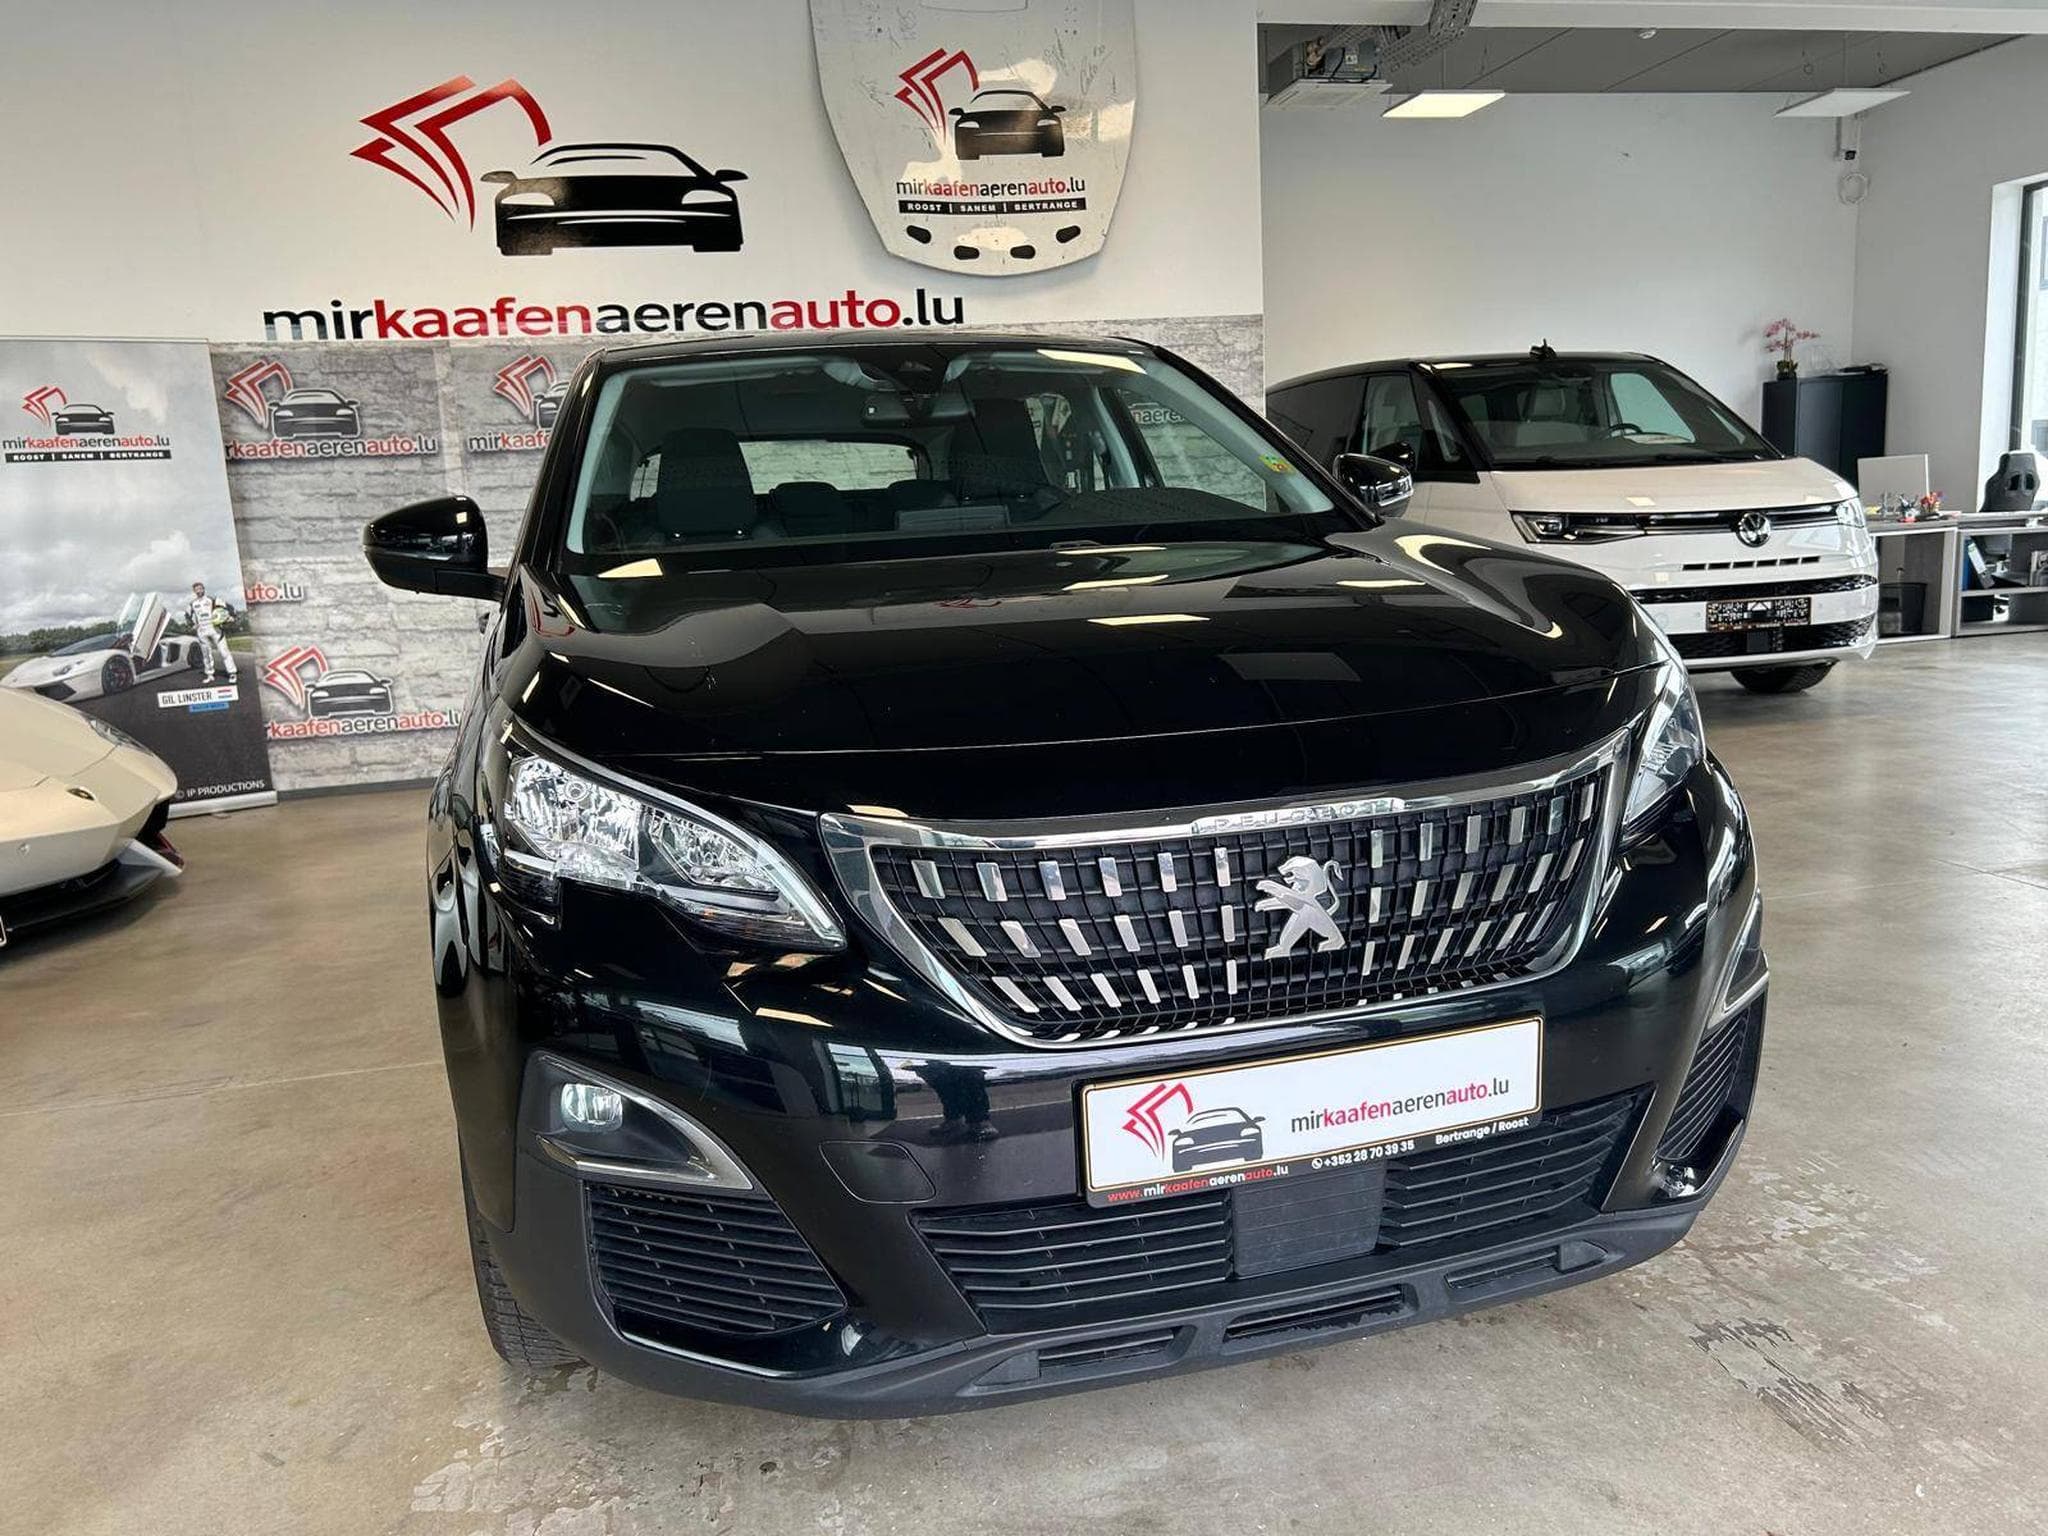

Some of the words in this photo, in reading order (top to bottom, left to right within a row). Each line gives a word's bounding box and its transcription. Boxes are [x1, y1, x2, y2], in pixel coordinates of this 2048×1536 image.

[896, 177, 1086, 198] mirkaafenaerenauto.lu
[907, 203, 943, 212] ROOST
[1014, 201, 1078, 212] BERTRANGE
[263, 289, 964, 341] mirkaafenaerenauto.lu
[3, 435, 171, 449] mirkaafenaerenauto.lu
[225, 435, 437, 458] rkaafenaerenauto.lu
[162, 696, 176, 704] GIL
[177, 691, 212, 702] LINSTER
[187, 788, 197, 798] IP
[198, 780, 265, 796] PRODUCTIONS
[1291, 1078, 1510, 1132] mirkaafenaerenauto.lu
[1323, 1155, 1352, 1168] +352
[1353, 1152, 1368, 1163] 28
[1369, 1148, 1383, 1159] 70
[1384, 1144, 1399, 1156] 39
[1400, 1140, 1415, 1151] 35
[1435, 1125, 1490, 1145] Bertrange
[1498, 1117, 1529, 1132] Roost
[1107, 1165, 1289, 1202] www.mirkaafenaerenauto.lu
